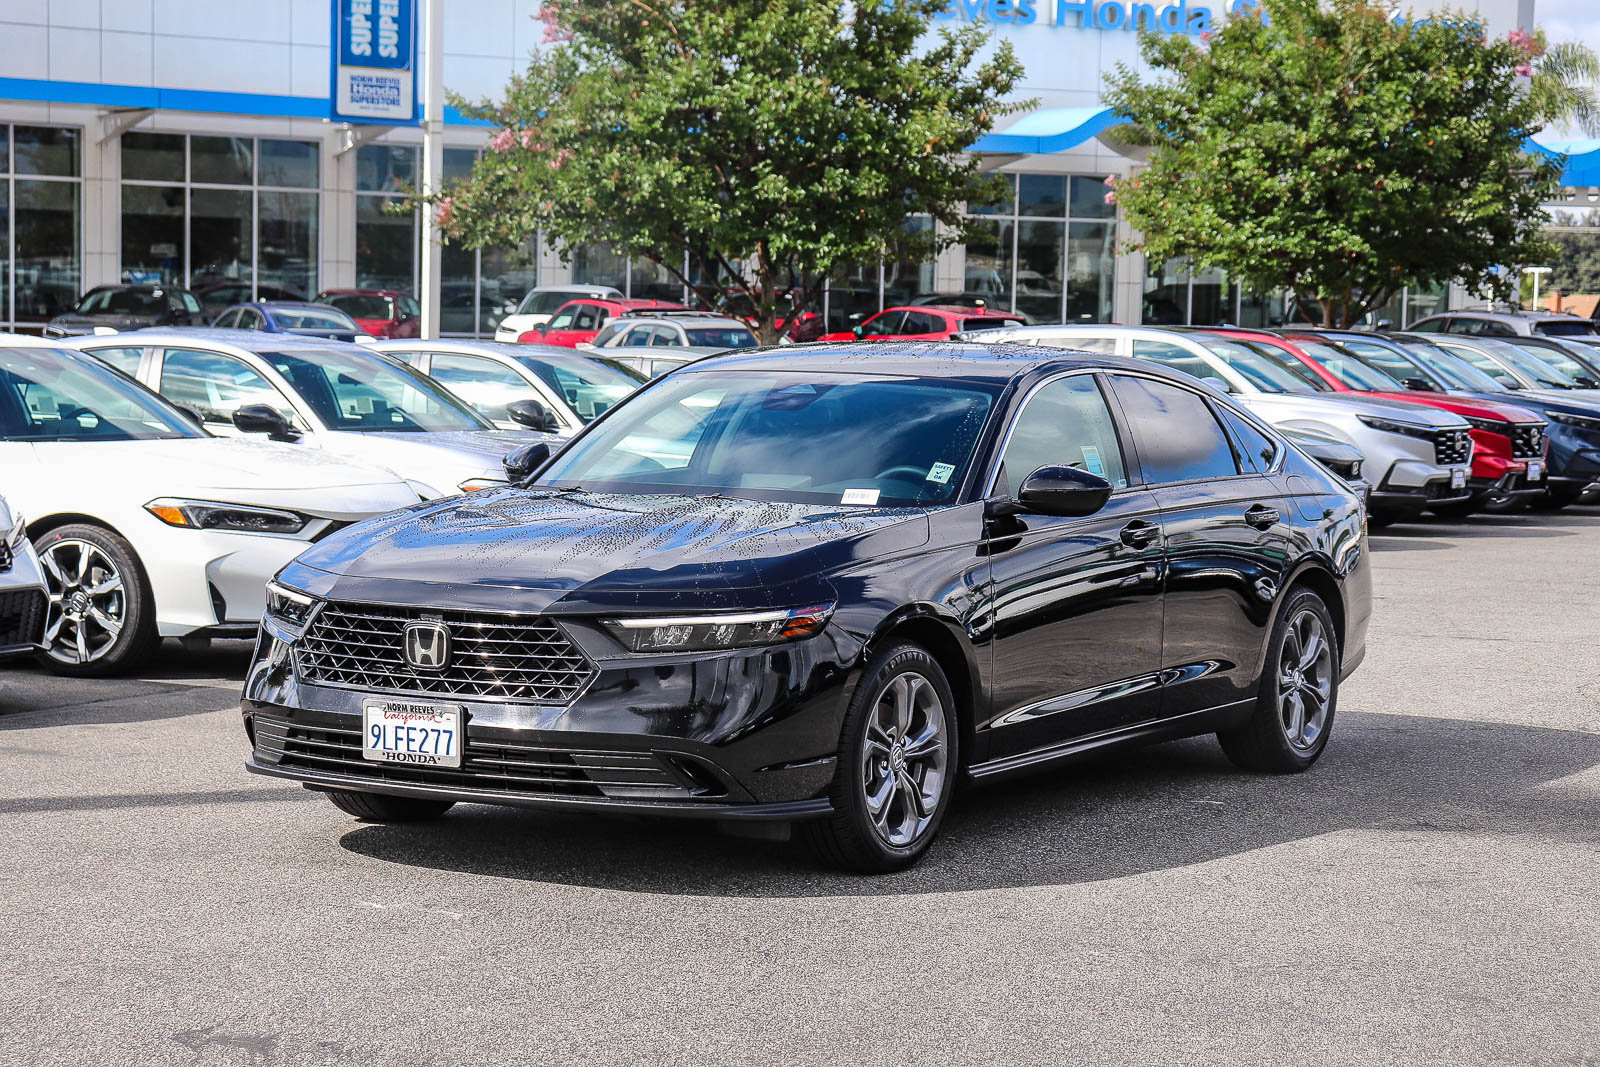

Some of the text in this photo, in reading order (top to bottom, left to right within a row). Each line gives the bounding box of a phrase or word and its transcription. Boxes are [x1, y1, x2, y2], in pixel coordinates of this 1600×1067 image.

[351, 0, 372, 56] SUPE
[1056, 0, 1212, 35] Honda
[351, 83, 400, 97] Honda
[387, 702, 435, 715] NORM REEVES
[371, 724, 453, 756] 9LFE277
[386, 752, 438, 765] HONDA
